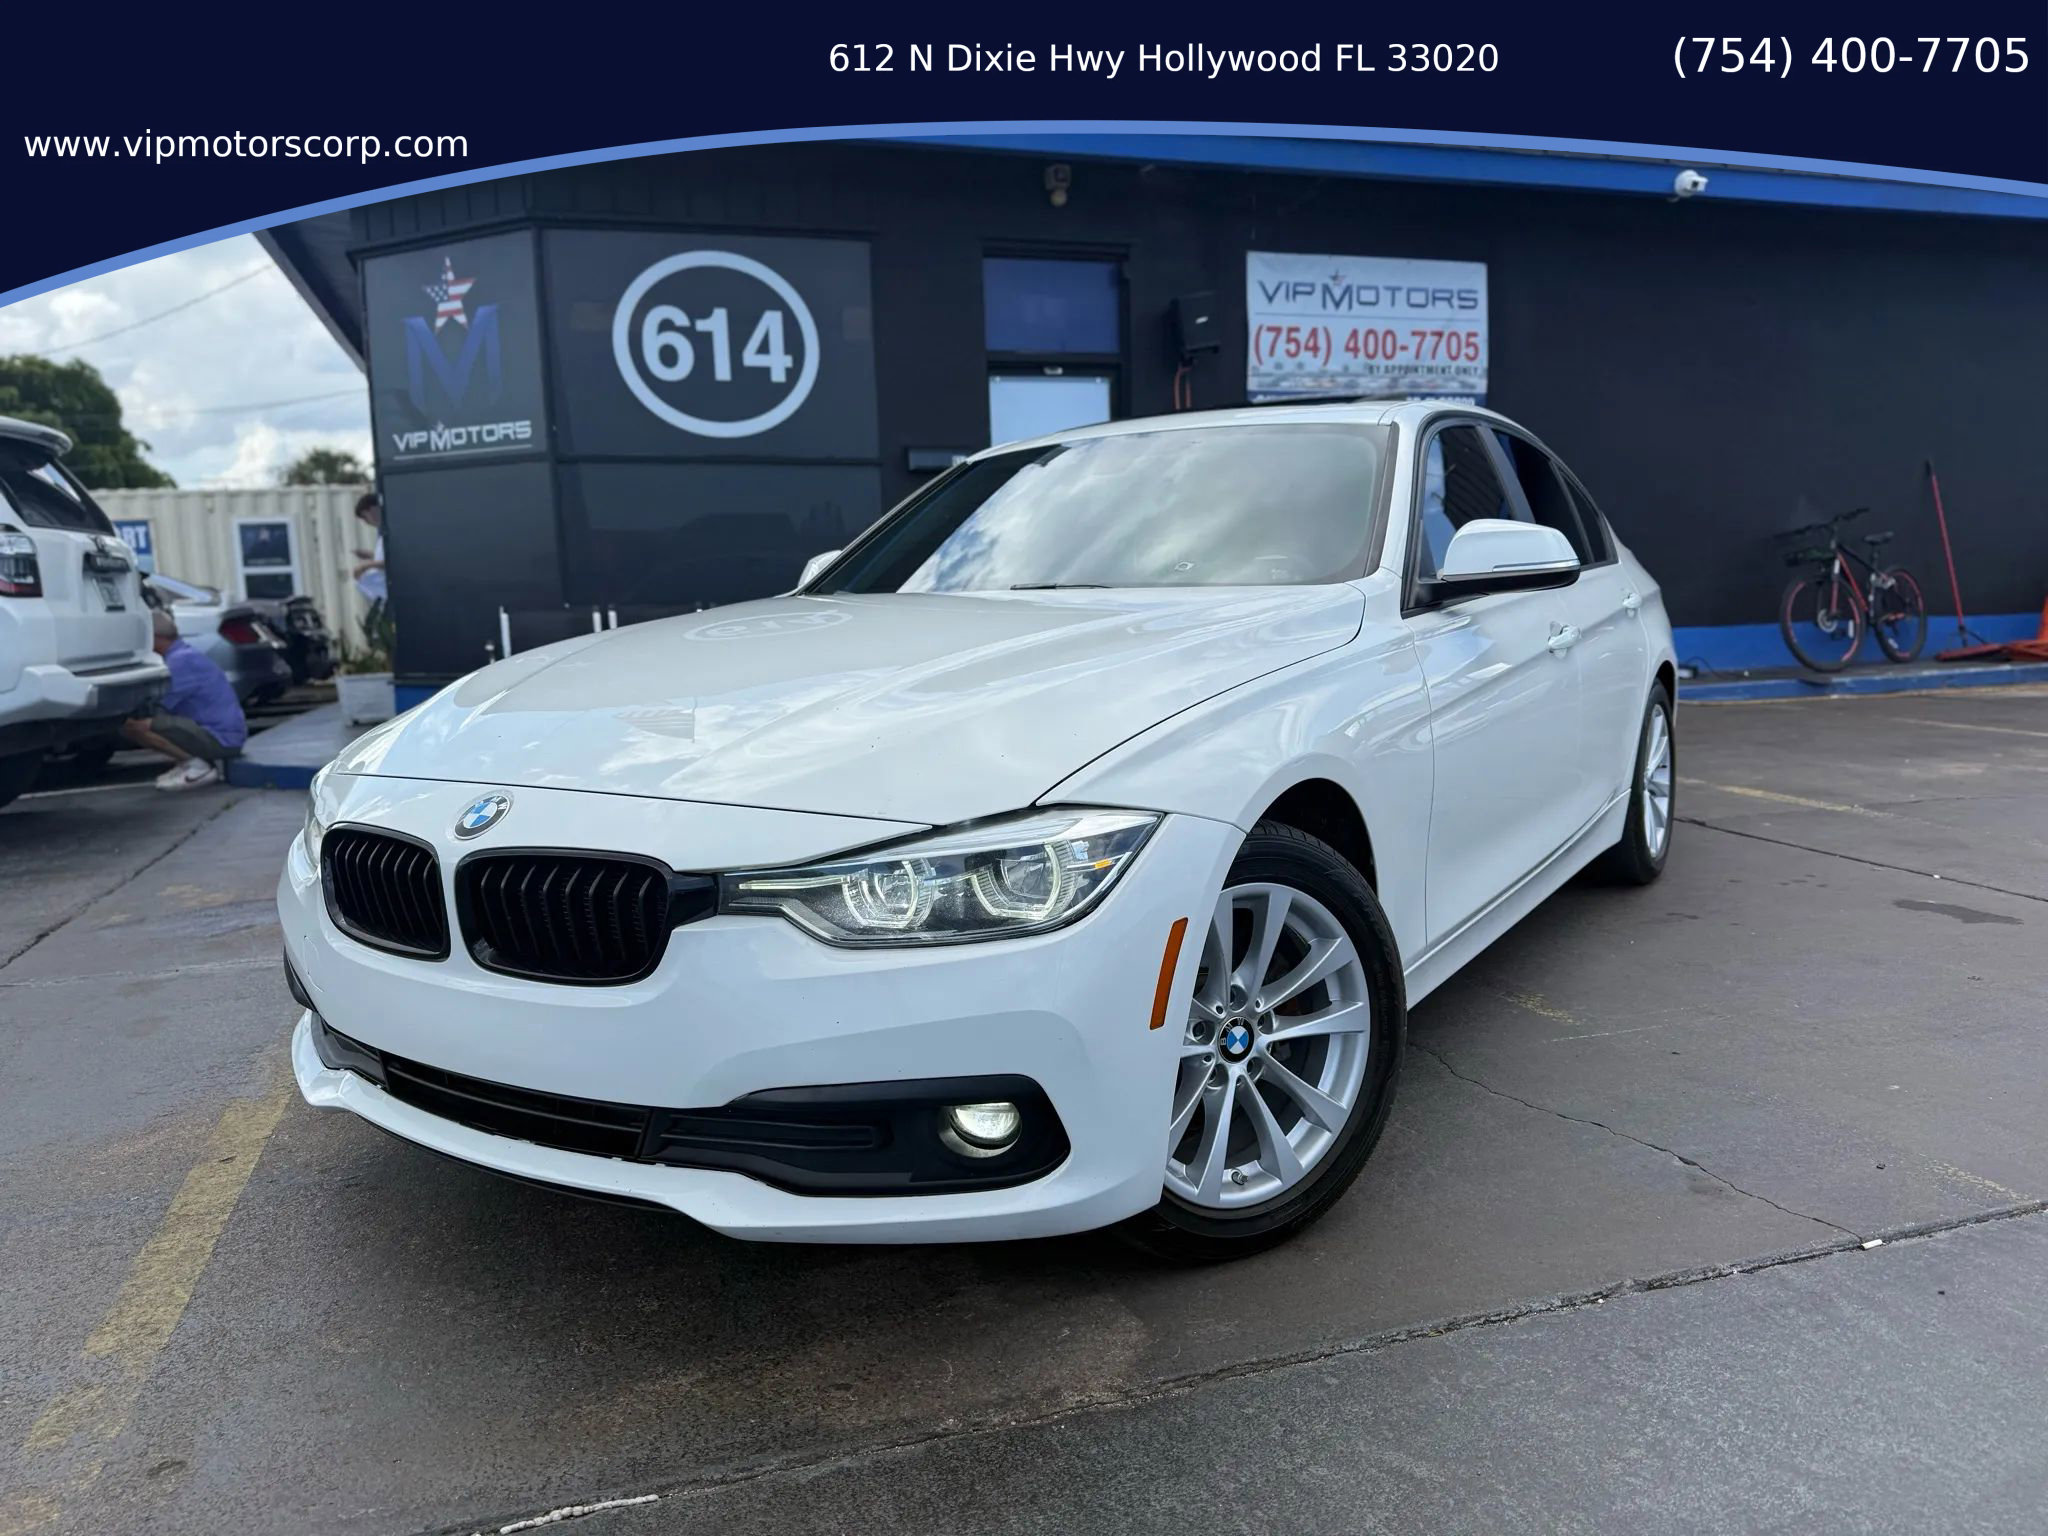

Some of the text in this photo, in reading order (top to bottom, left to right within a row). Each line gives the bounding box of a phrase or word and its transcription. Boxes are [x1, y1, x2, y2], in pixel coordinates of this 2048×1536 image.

[641, 304, 793, 383] 614
[1254, 324, 1480, 366] (754) 400-7705
